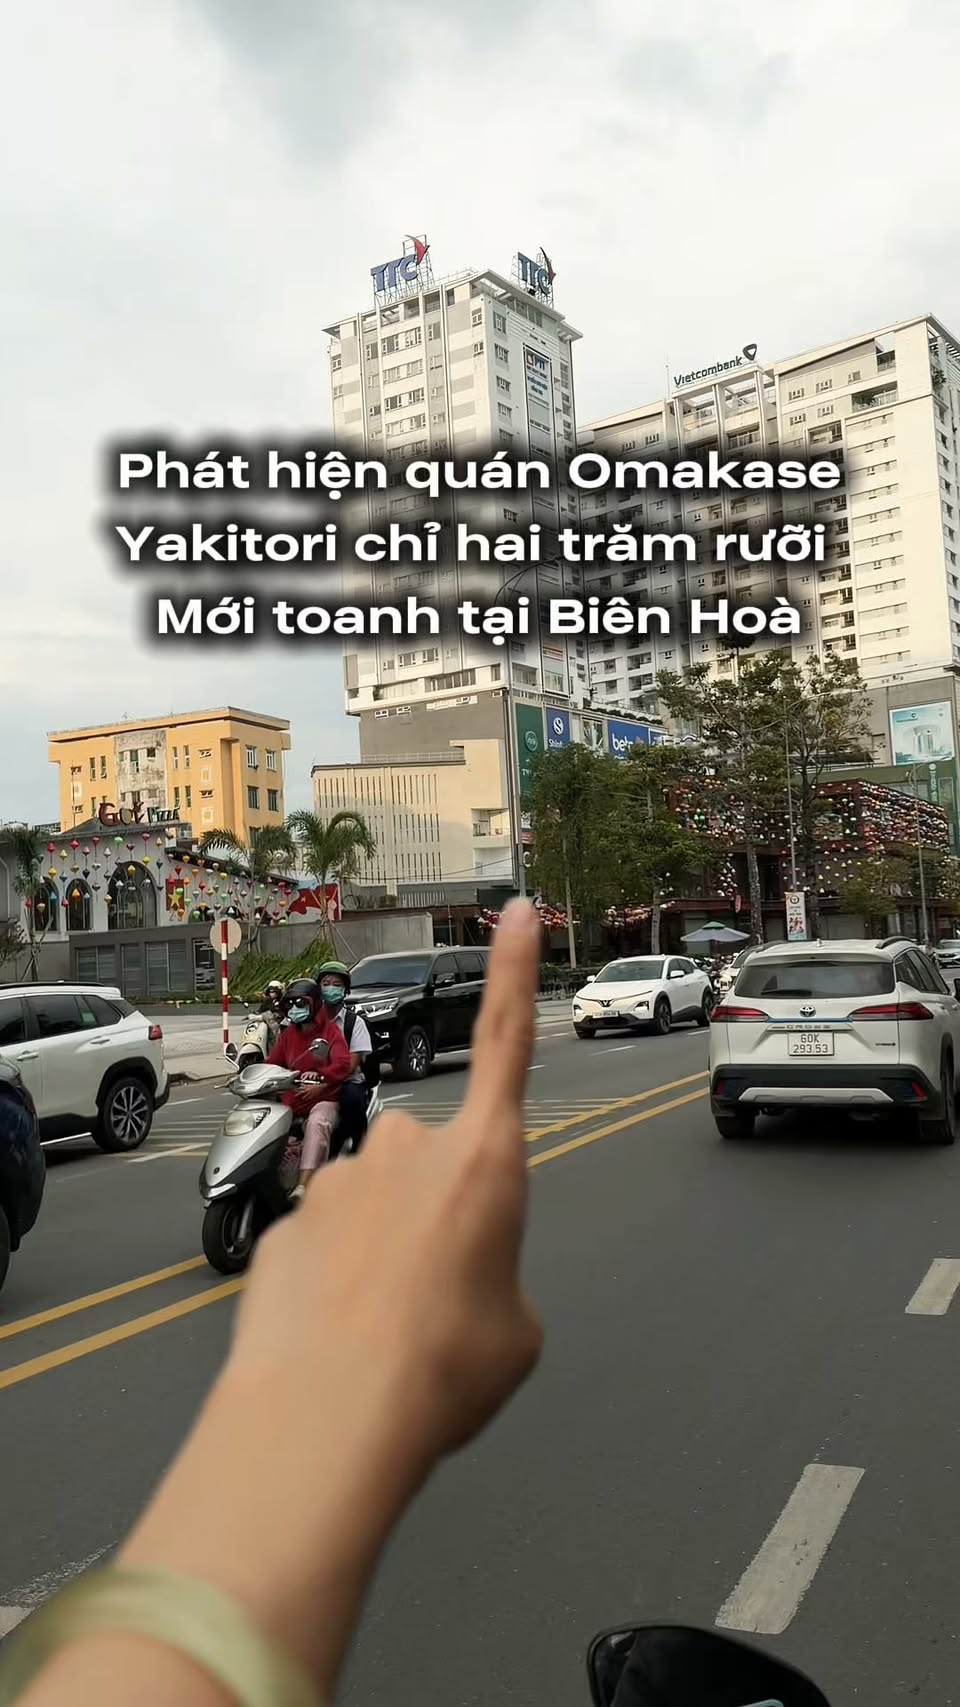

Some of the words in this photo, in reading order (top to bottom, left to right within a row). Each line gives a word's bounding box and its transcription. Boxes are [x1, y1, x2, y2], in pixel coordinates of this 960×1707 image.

[370, 253, 419, 293] TTC
[517, 251, 552, 295] TTC
[673, 355, 743, 386] Vietcombank
[99, 801, 145, 827] Got
[793, 1044, 829, 1054] 293.53
[800, 1033, 820, 1043] 60K
